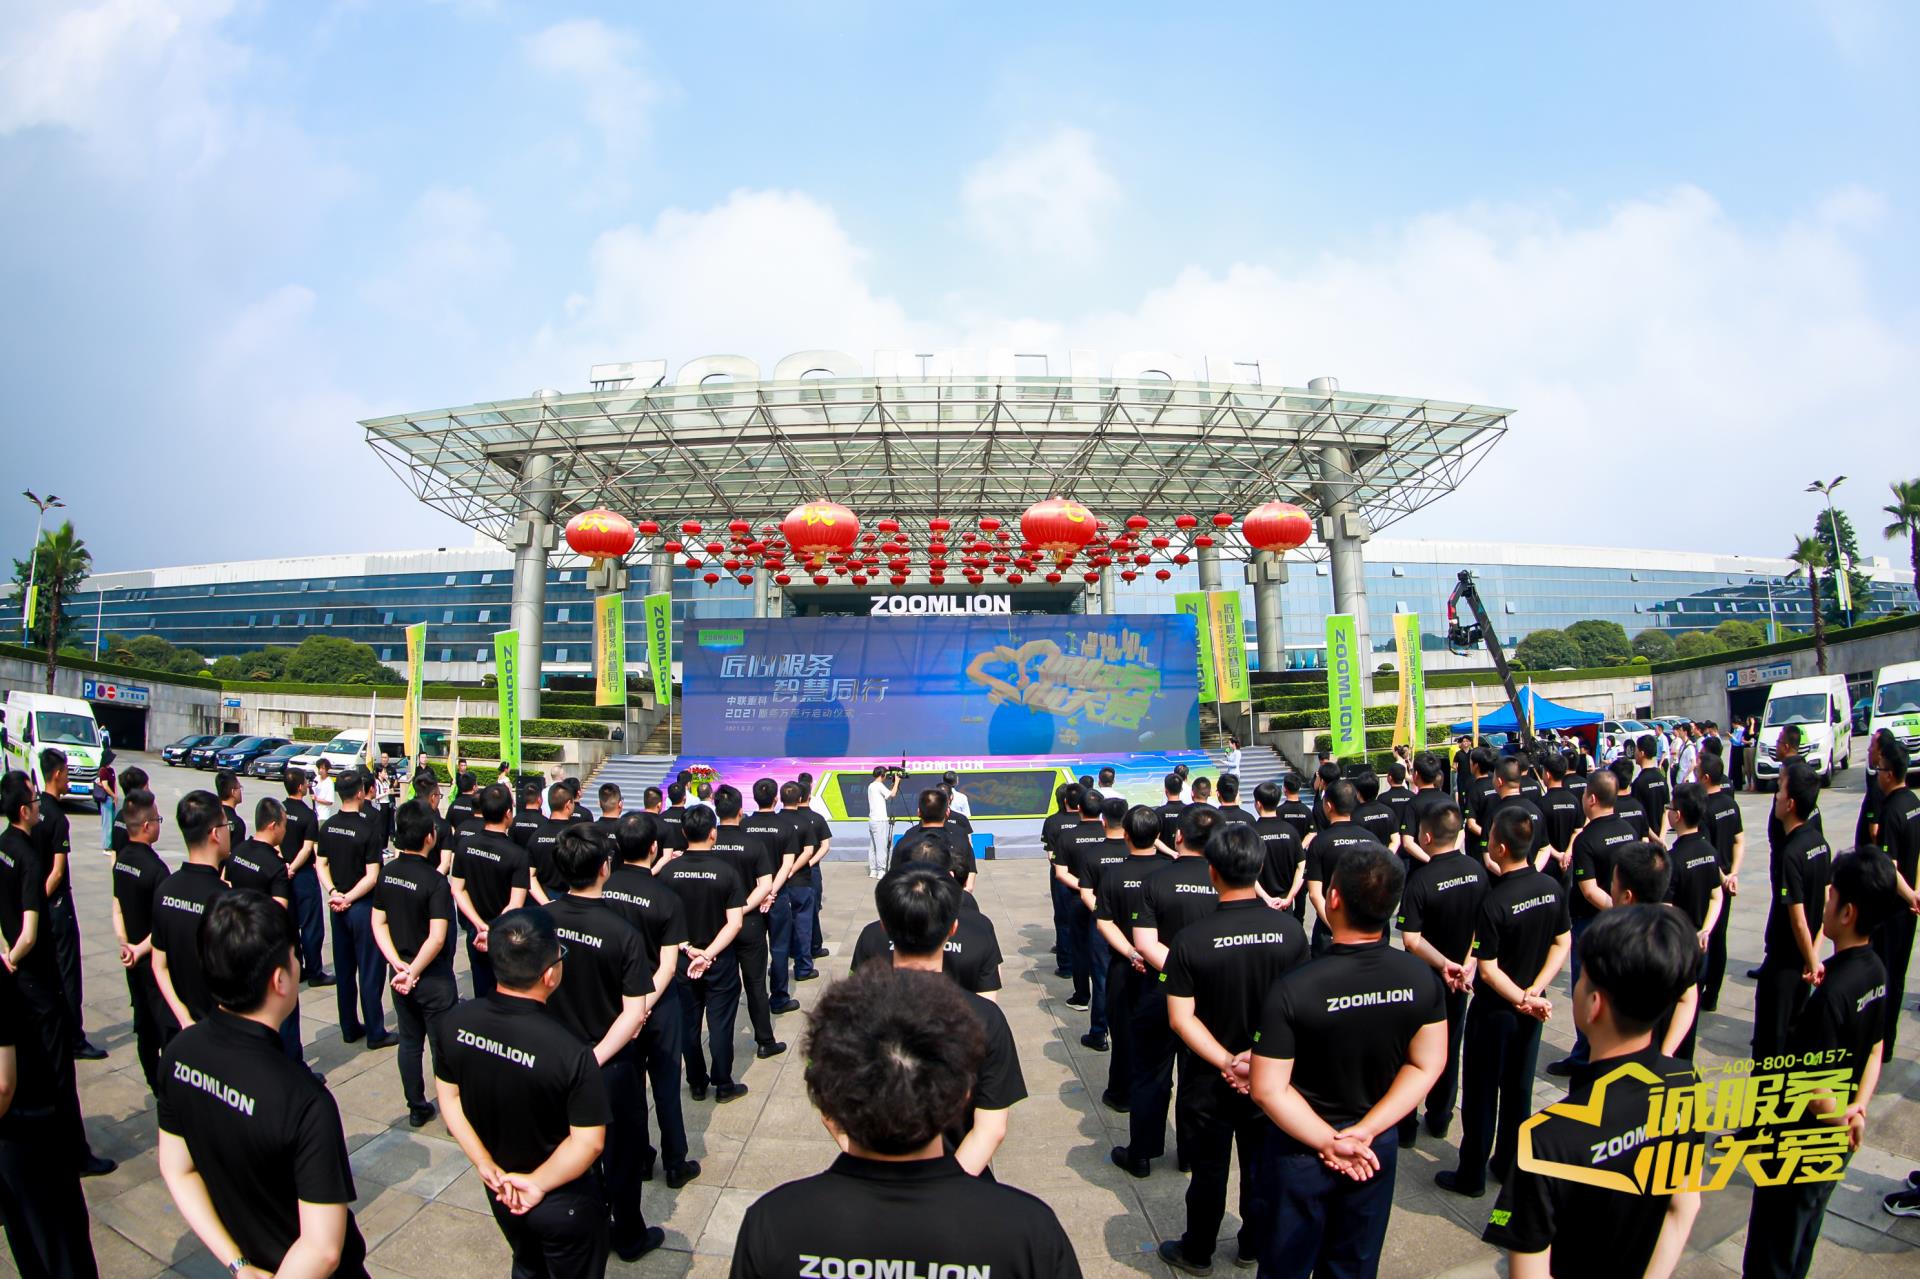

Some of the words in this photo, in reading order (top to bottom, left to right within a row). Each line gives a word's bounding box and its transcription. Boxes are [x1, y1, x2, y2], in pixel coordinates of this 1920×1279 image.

[870, 594, 1011, 614] ZOOMLION
[1335, 628, 1353, 742] ZOOMLION
[1727, 673, 1734, 687] P
[84, 682, 92, 697] P
[1364, 813, 1389, 822] ZOOMLION
[327, 826, 356, 838] ZOOMLION
[1605, 833, 1634, 846] ZOOMLION
[466, 847, 501, 862] ZOOMLION
[1686, 855, 1716, 870] ZOOMLION
[115, 862, 141, 879] ZOOMLION
[234, 855, 260, 873] ZOOMLION
[384, 875, 417, 891] ZOOMLION
[673, 872, 717, 880] ZOOMLION
[1437, 874, 1478, 892] ZOOMLION
[1512, 894, 1555, 915] ZOOMLION
[555, 928, 602, 948] OMLION
[1214, 933, 1283, 949] ZOOMLION
[1326, 988, 1414, 1013] ZOOMLION
[457, 1029, 536, 1068] ZOOMLION
[174, 1061, 255, 1116] ZOOMLION
[799, 1254, 991, 1279] ZOOMLION
